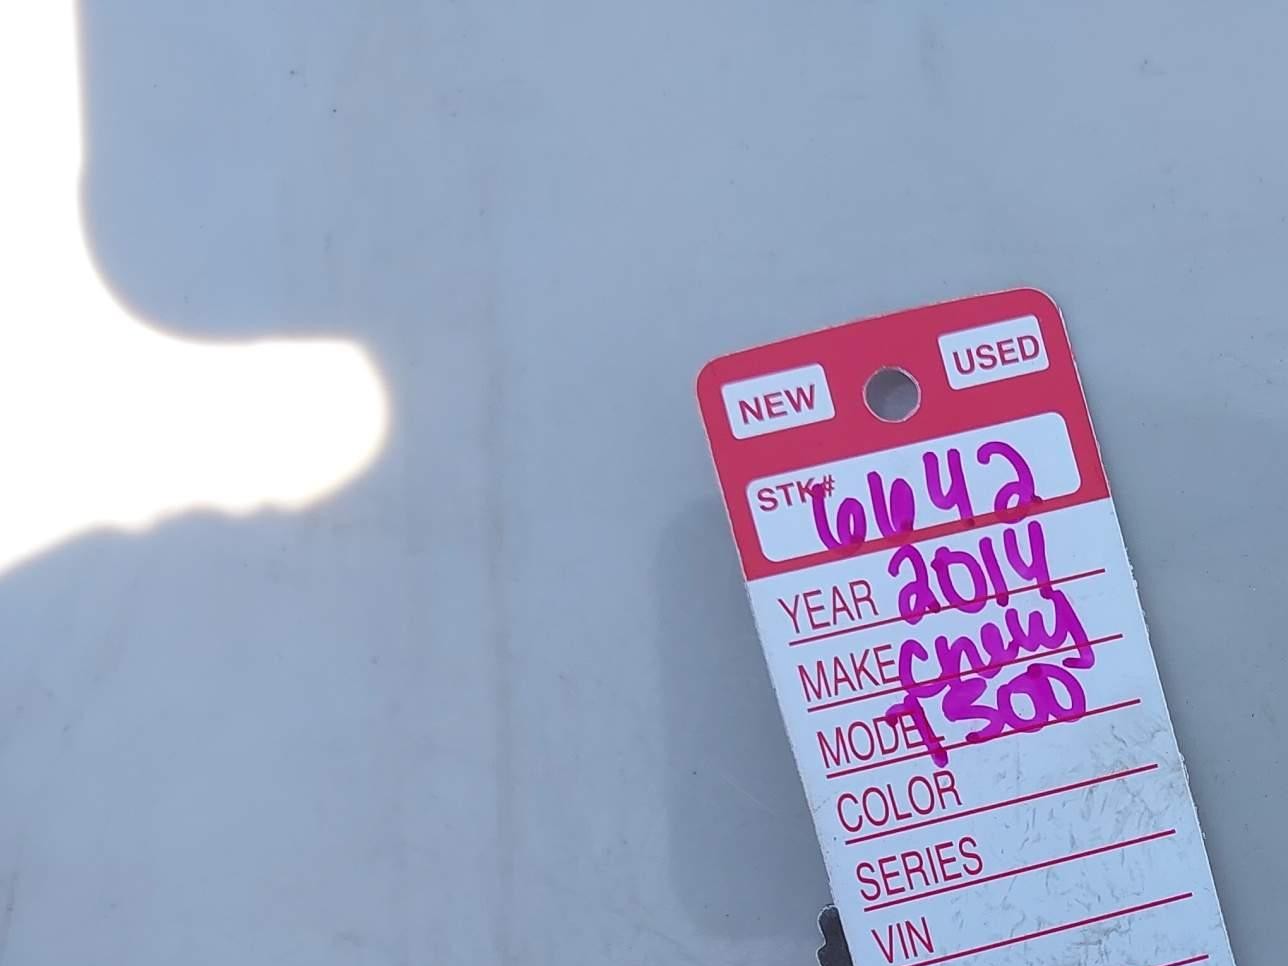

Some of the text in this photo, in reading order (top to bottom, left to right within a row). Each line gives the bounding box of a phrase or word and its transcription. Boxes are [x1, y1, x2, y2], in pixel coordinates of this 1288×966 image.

[953, 335, 1040, 375] USED
[738, 384, 816, 424] NEW
[812, 441, 1044, 555] 6642
[887, 520, 1053, 625] 2014
[778, 580, 879, 634] YEAR
[797, 645, 902, 702] MAKE
[836, 770, 963, 833] COLOR
[856, 837, 984, 902] SERIES
[871, 917, 935, 964] VIN
